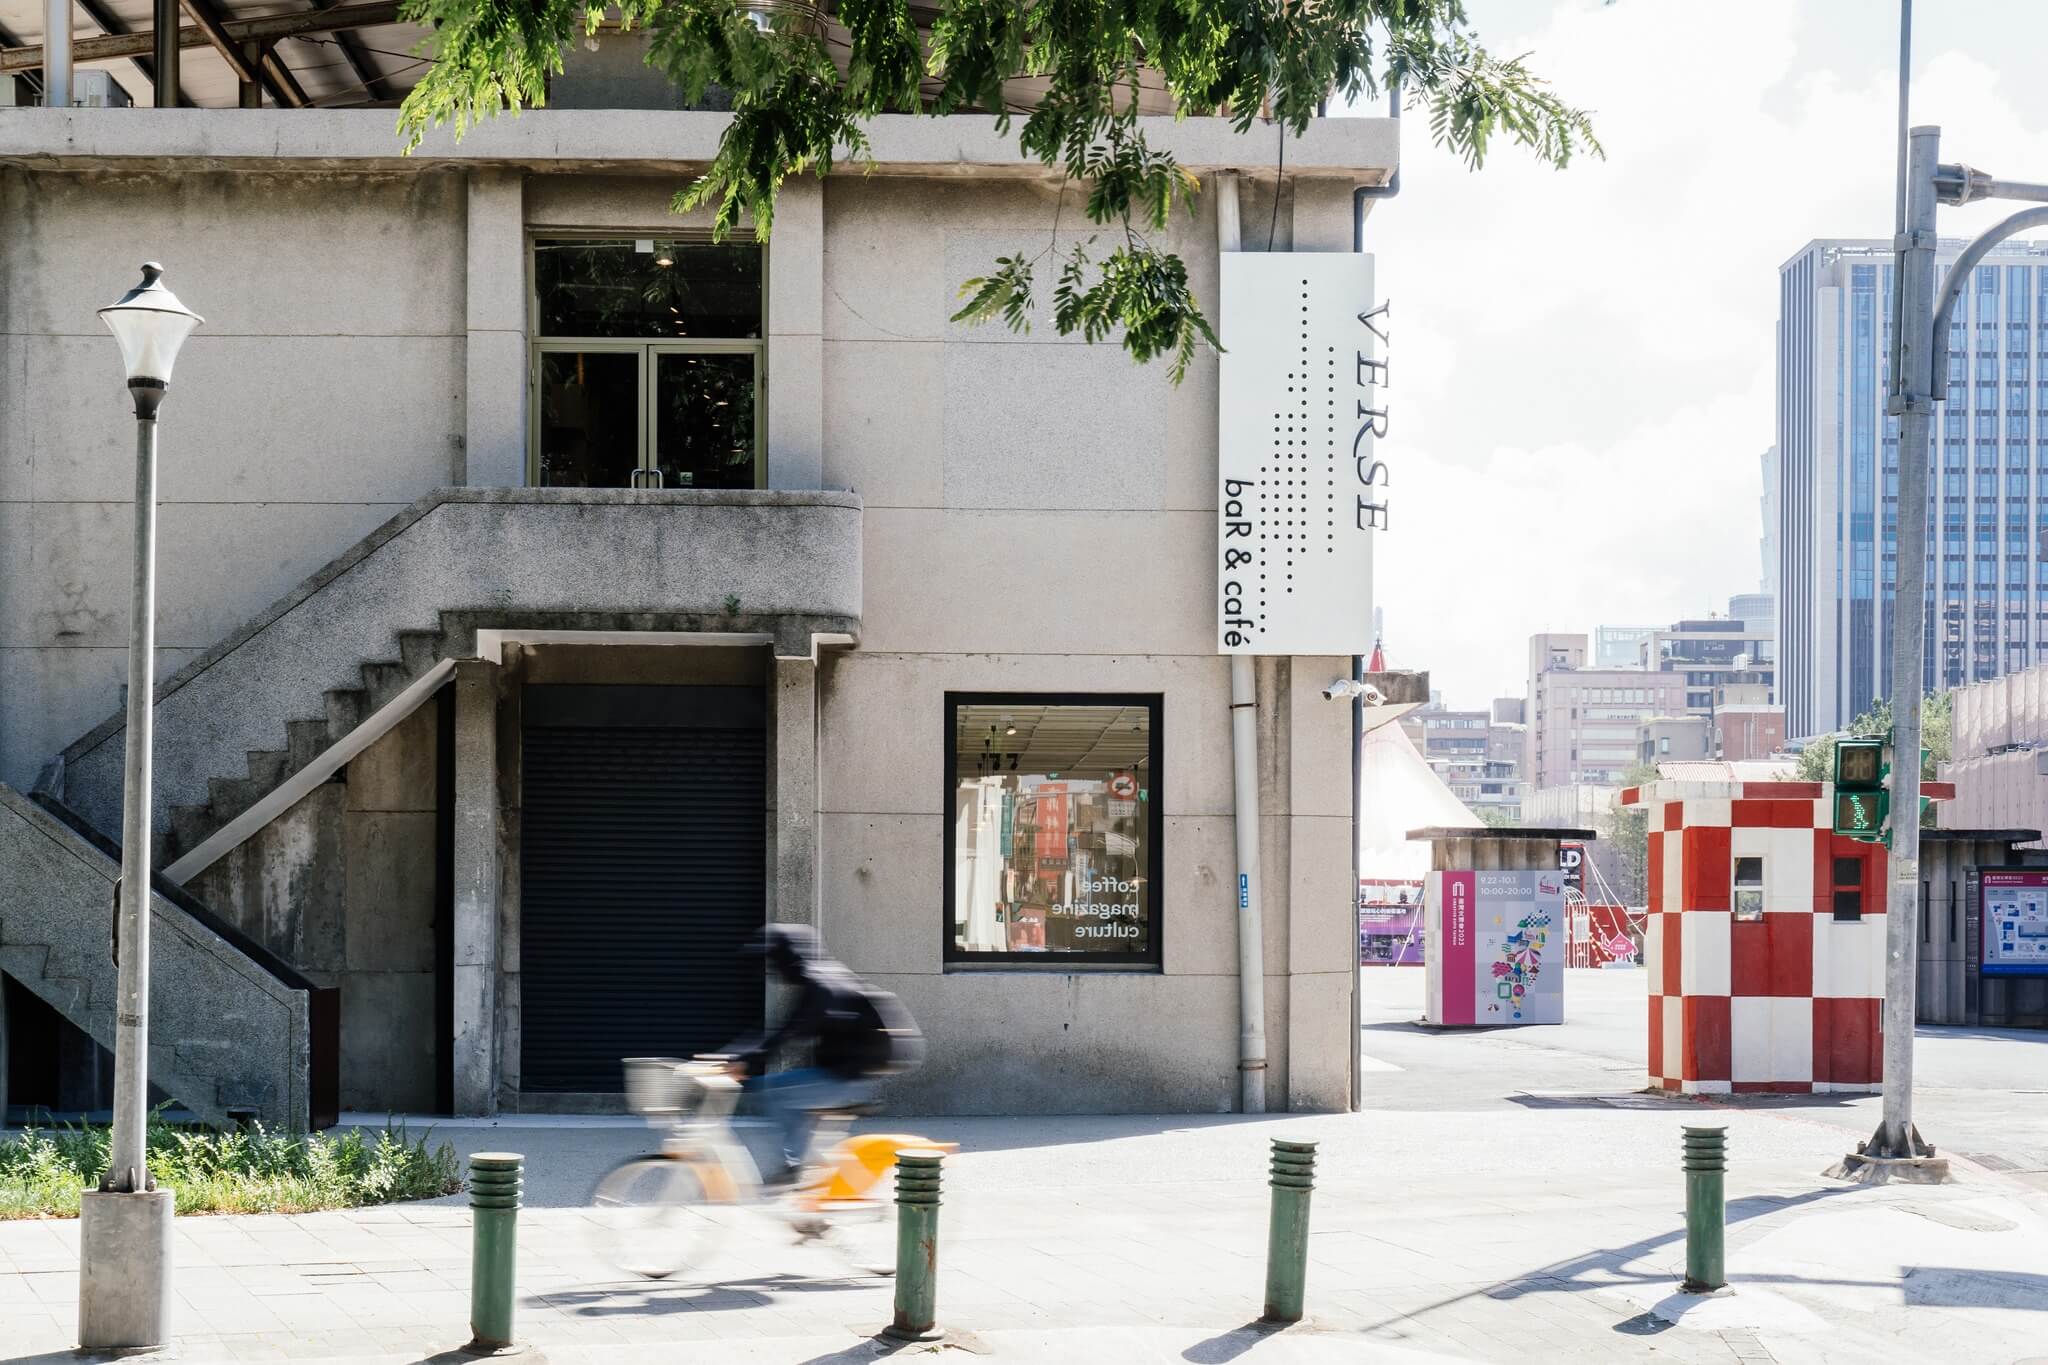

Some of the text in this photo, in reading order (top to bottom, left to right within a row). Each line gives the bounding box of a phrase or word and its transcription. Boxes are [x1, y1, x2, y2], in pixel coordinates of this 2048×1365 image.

[1353, 298, 1390, 531] VERSE
[1224, 479, 1254, 647] baR & café
